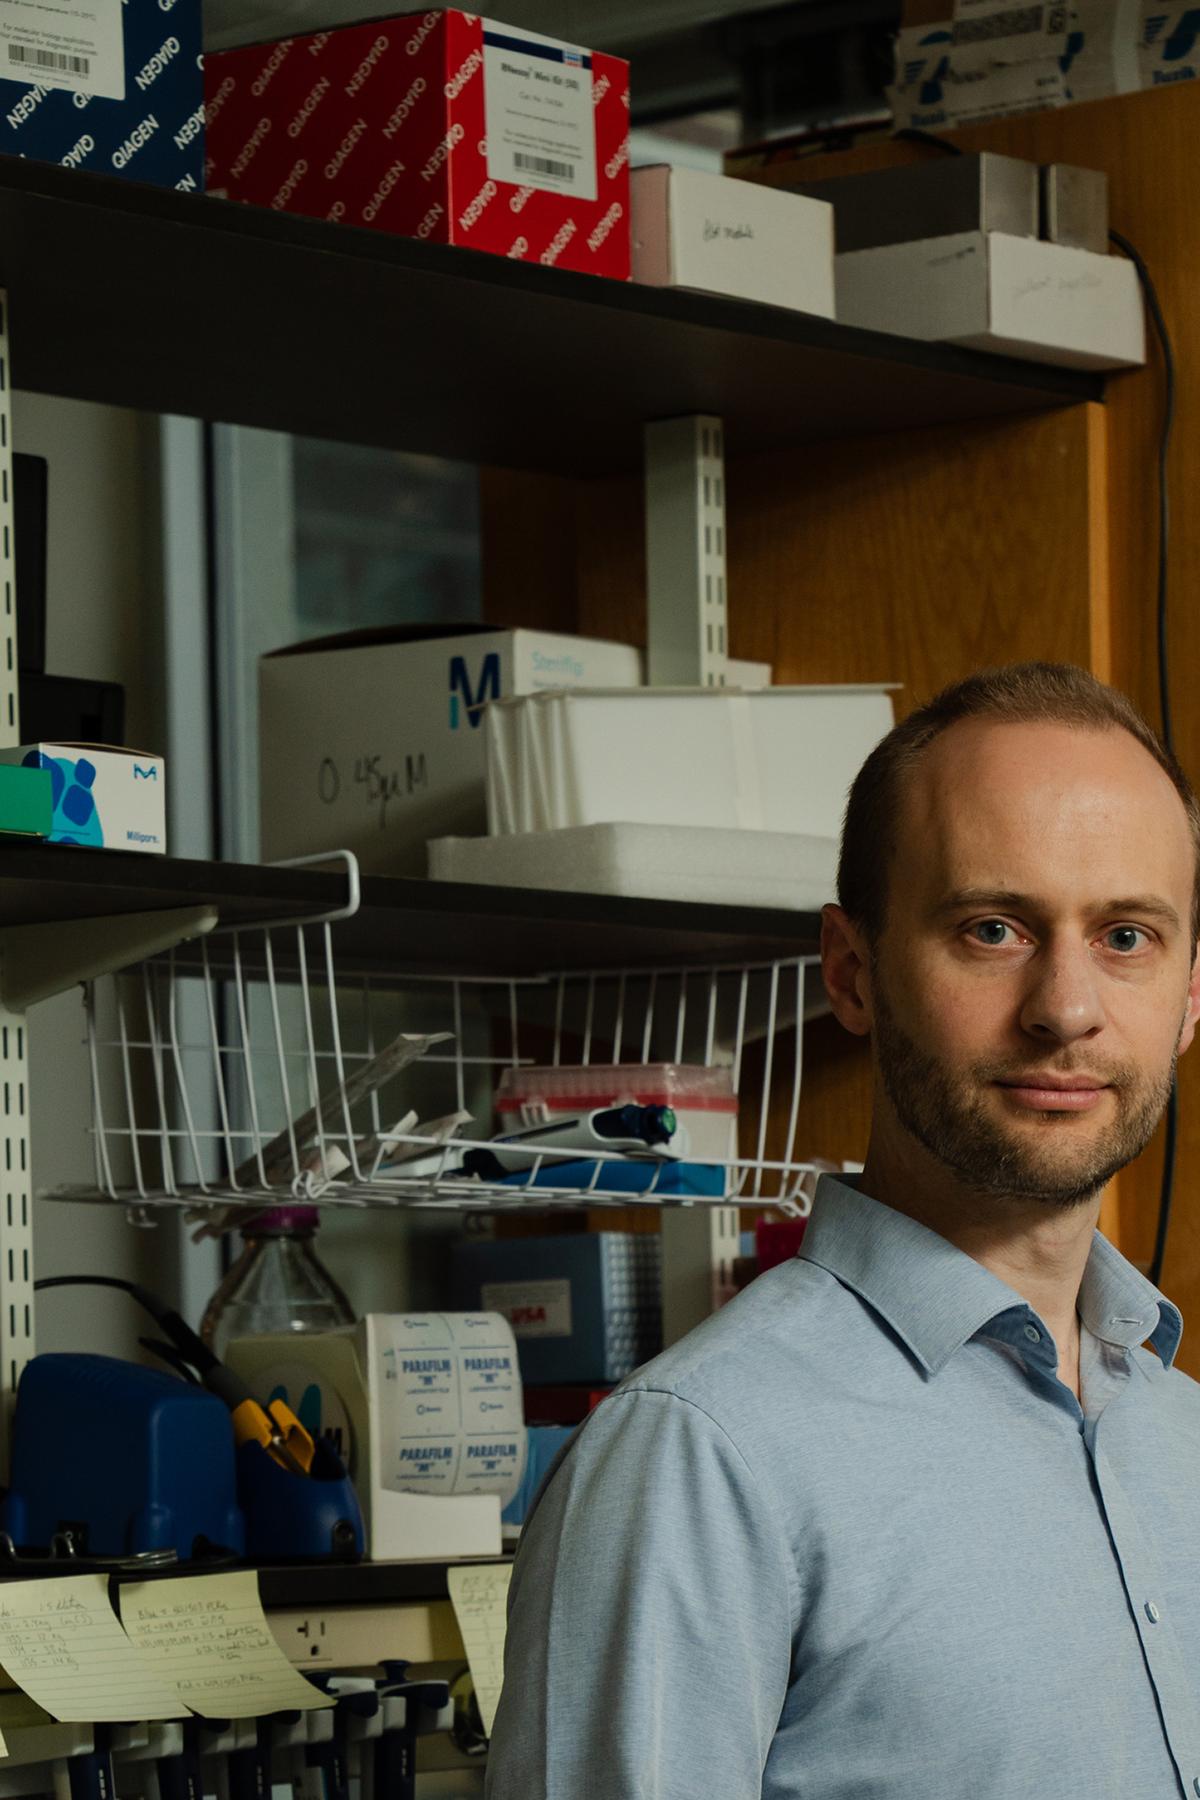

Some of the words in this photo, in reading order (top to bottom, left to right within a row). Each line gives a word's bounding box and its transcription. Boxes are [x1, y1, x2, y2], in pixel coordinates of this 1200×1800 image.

[405, 11, 442, 56] QIAG
[134, 36, 181, 91] QIAGEN
[250, 39, 294, 97] QIAGEN
[345, 35, 389, 98] QIAGEN
[444, 48, 484, 99] QIAGEN
[5, 83, 54, 130] IAGEN
[205, 76, 236, 122] QIAG
[287, 76, 331, 138] QIAGEN
[382, 77, 427, 139] QIAGEN
[57, 134, 95, 169] QIAG
[111, 113, 160, 169] QIAGEN
[173, 104, 206, 150] AGEN
[230, 117, 272, 179] QIAGEN
[324, 117, 368, 180] QIAGEN
[420, 123, 465, 182] QIAGEN
[270, 158, 308, 211] QIAGE
[362, 160, 406, 222] QIAGEN
[458, 180, 498, 232] QIAGEN
[412, 202, 445, 239] GEN
[586, 201, 624, 253] QIAGEN
[402, 1359, 451, 1374] PARAFILM
[464, 1357, 512, 1371] PARAFILM
[399, 1447, 453, 1461] PARAFILM
[466, 1443, 517, 1459] PARAFILM
